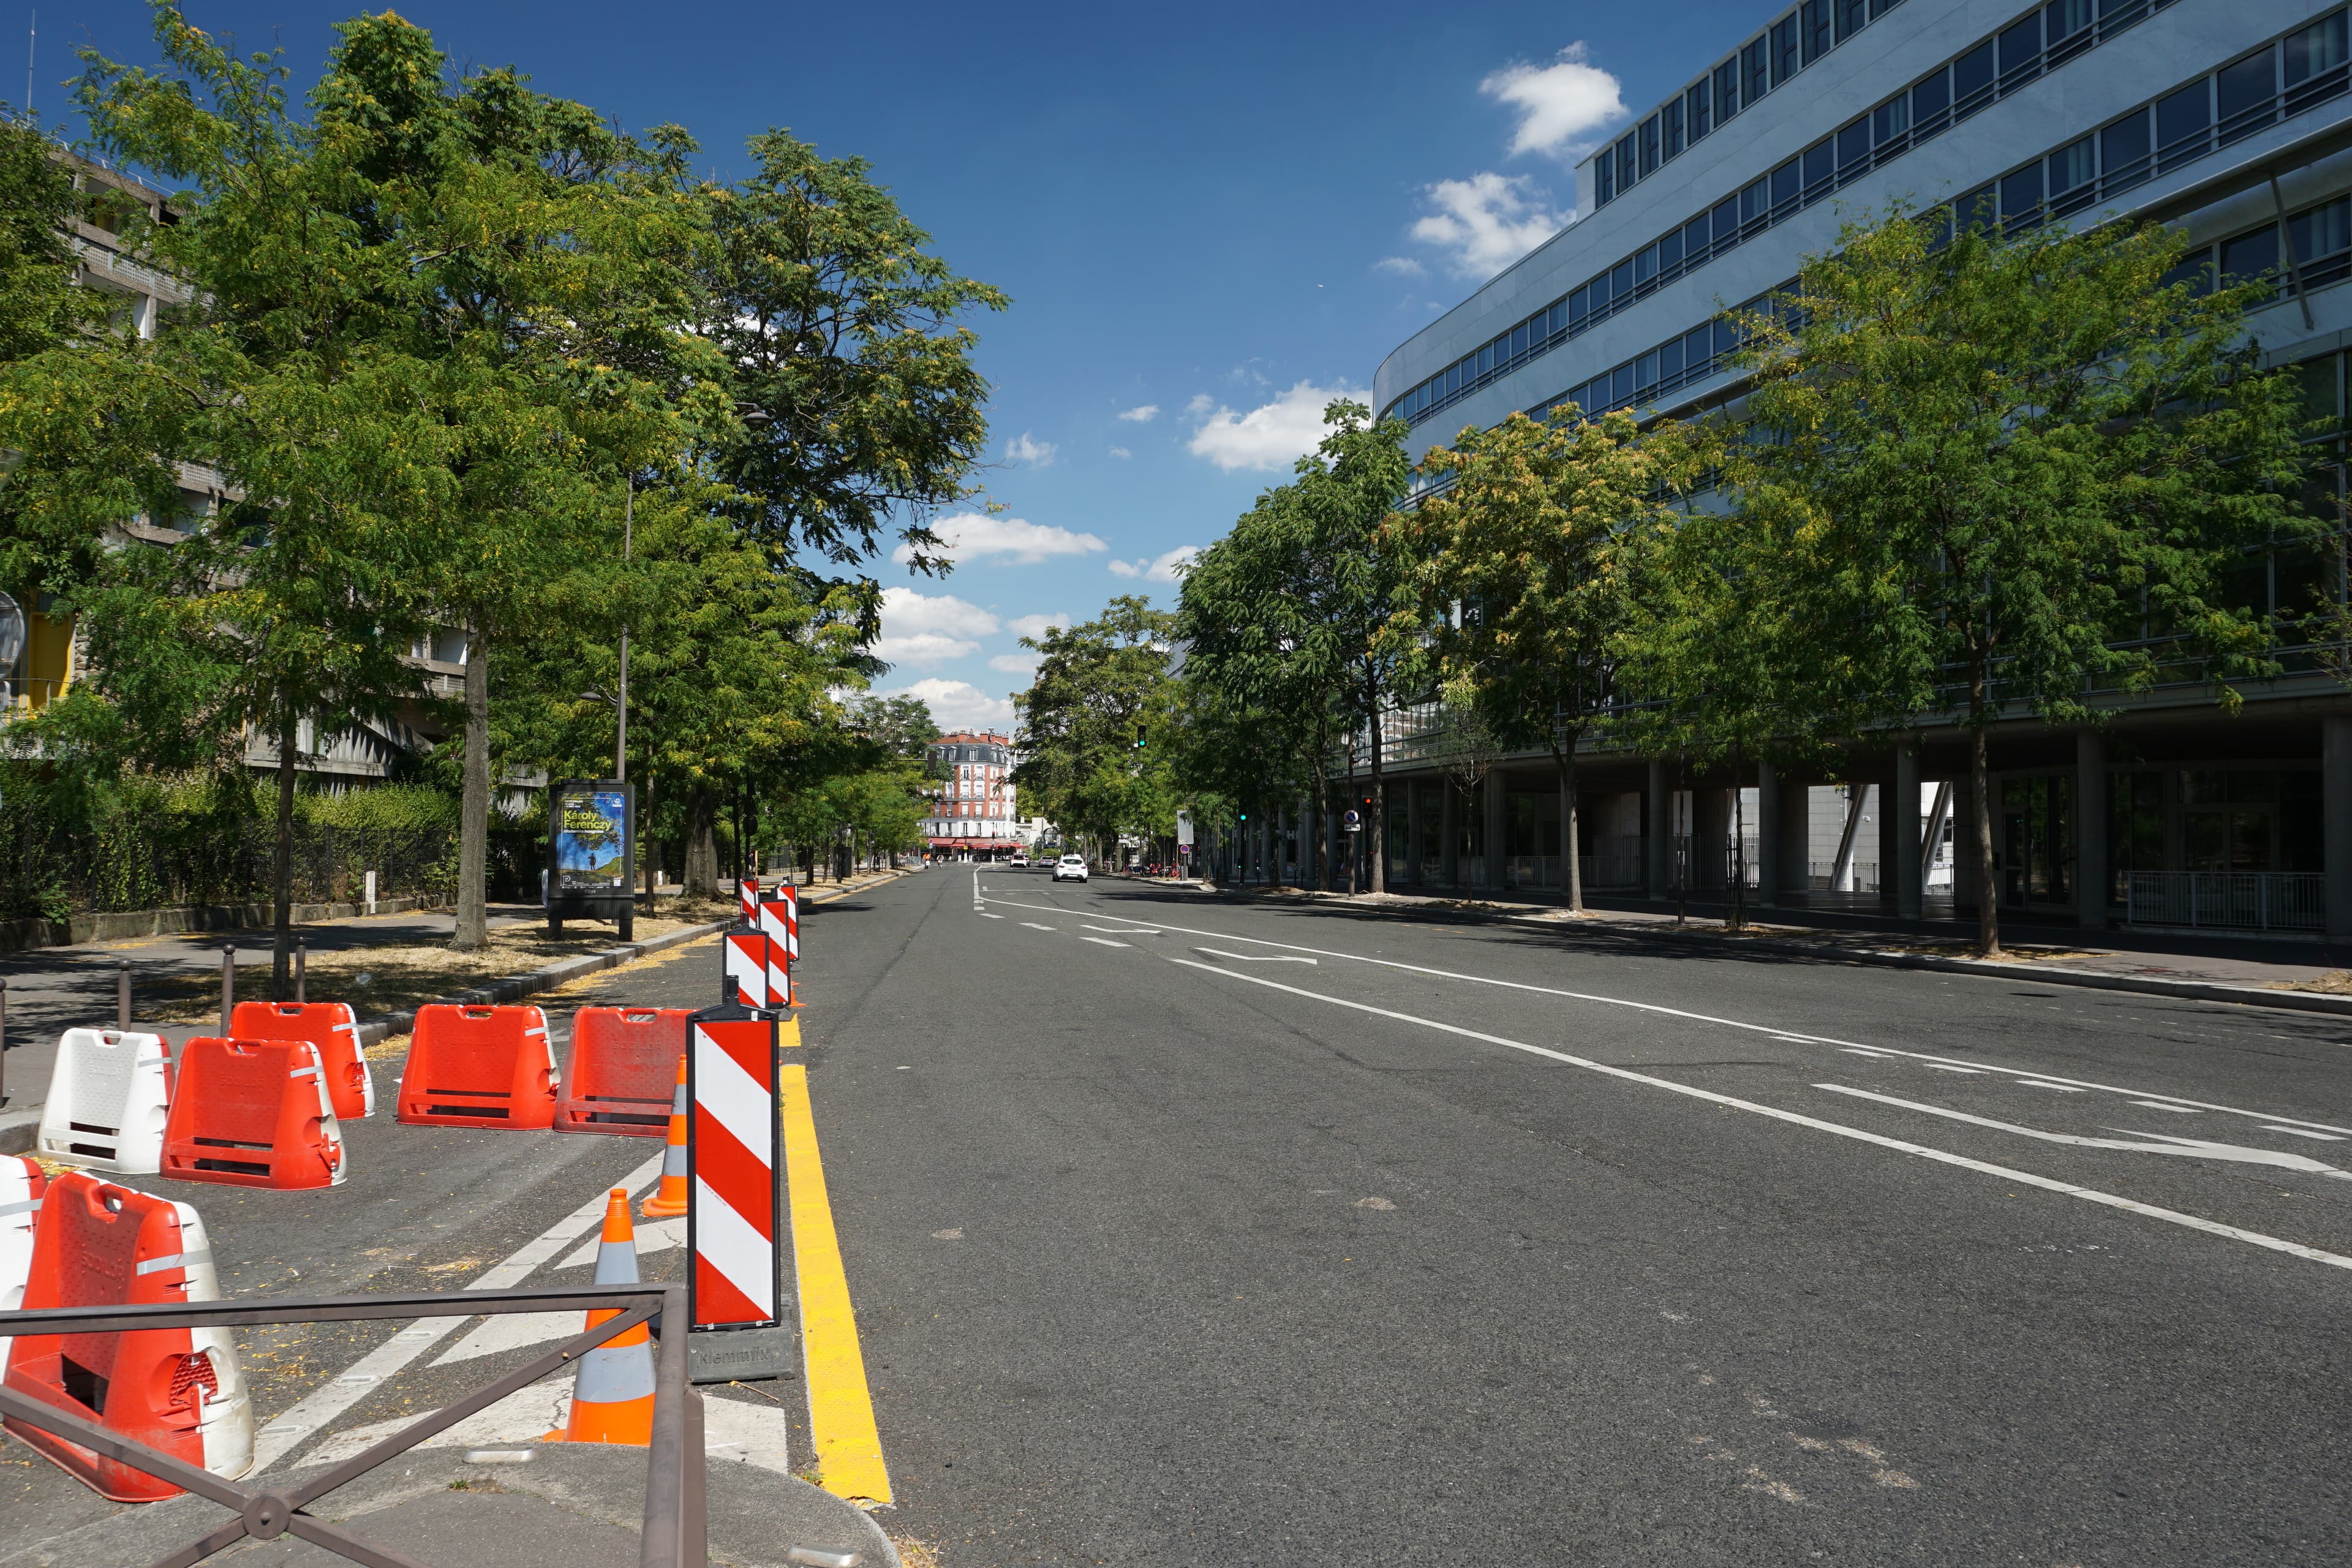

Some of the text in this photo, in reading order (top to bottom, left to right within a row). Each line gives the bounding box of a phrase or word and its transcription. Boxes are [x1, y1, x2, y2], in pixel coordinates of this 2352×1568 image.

[564, 810, 597, 822] Károly
[564, 820, 611, 832] Ferenczy
[699, 1346, 771, 1365] klemmfix
